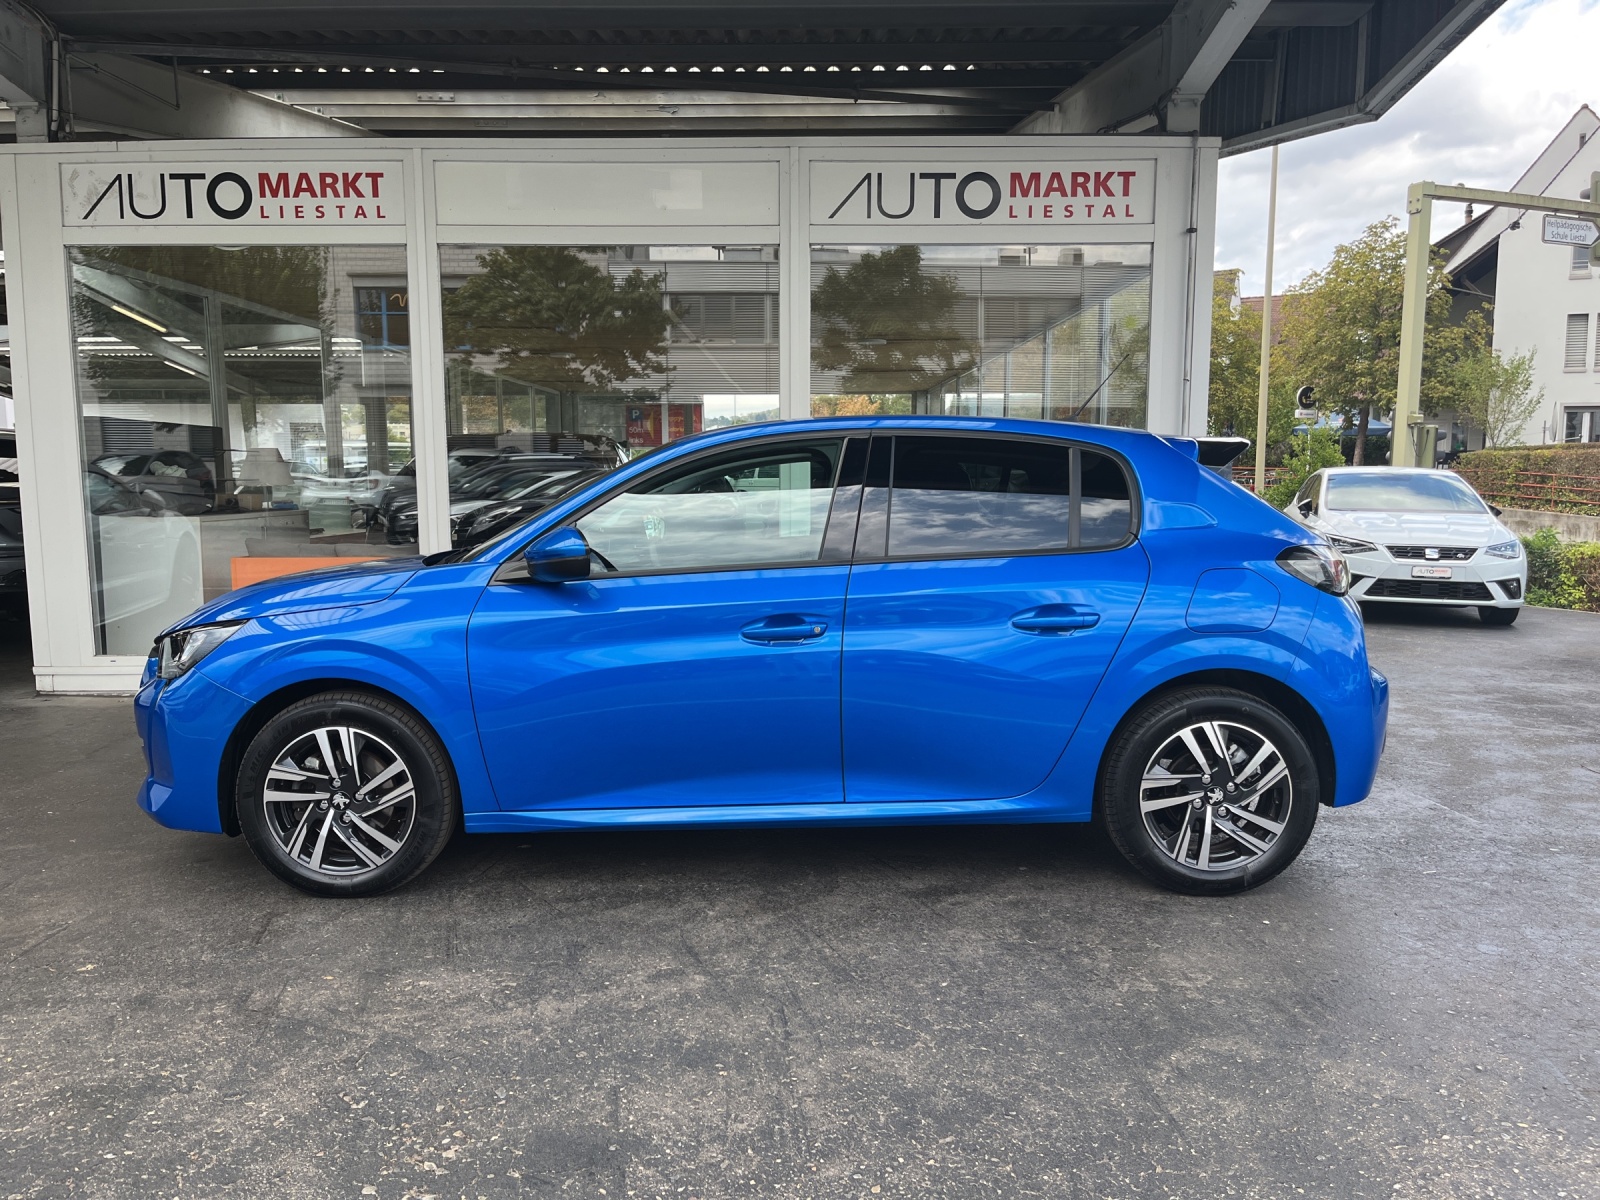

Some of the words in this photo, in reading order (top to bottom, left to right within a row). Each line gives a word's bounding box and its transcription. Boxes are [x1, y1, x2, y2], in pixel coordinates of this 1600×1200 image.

[82, 171, 253, 220] AUTO
[258, 172, 385, 199] MARKT
[828, 171, 1002, 220] AUTO
[1009, 171, 1137, 198] MARKT
[260, 205, 387, 219] LIESTAL
[1009, 204, 1135, 218] LIESTAL
[1546, 219, 1593, 232] Heilpädagogische
[1551, 231, 1568, 240] Schule
[1570, 233, 1587, 242] Liestal
[632, 409, 640, 419] P
[629, 426, 644, 434] 50m
